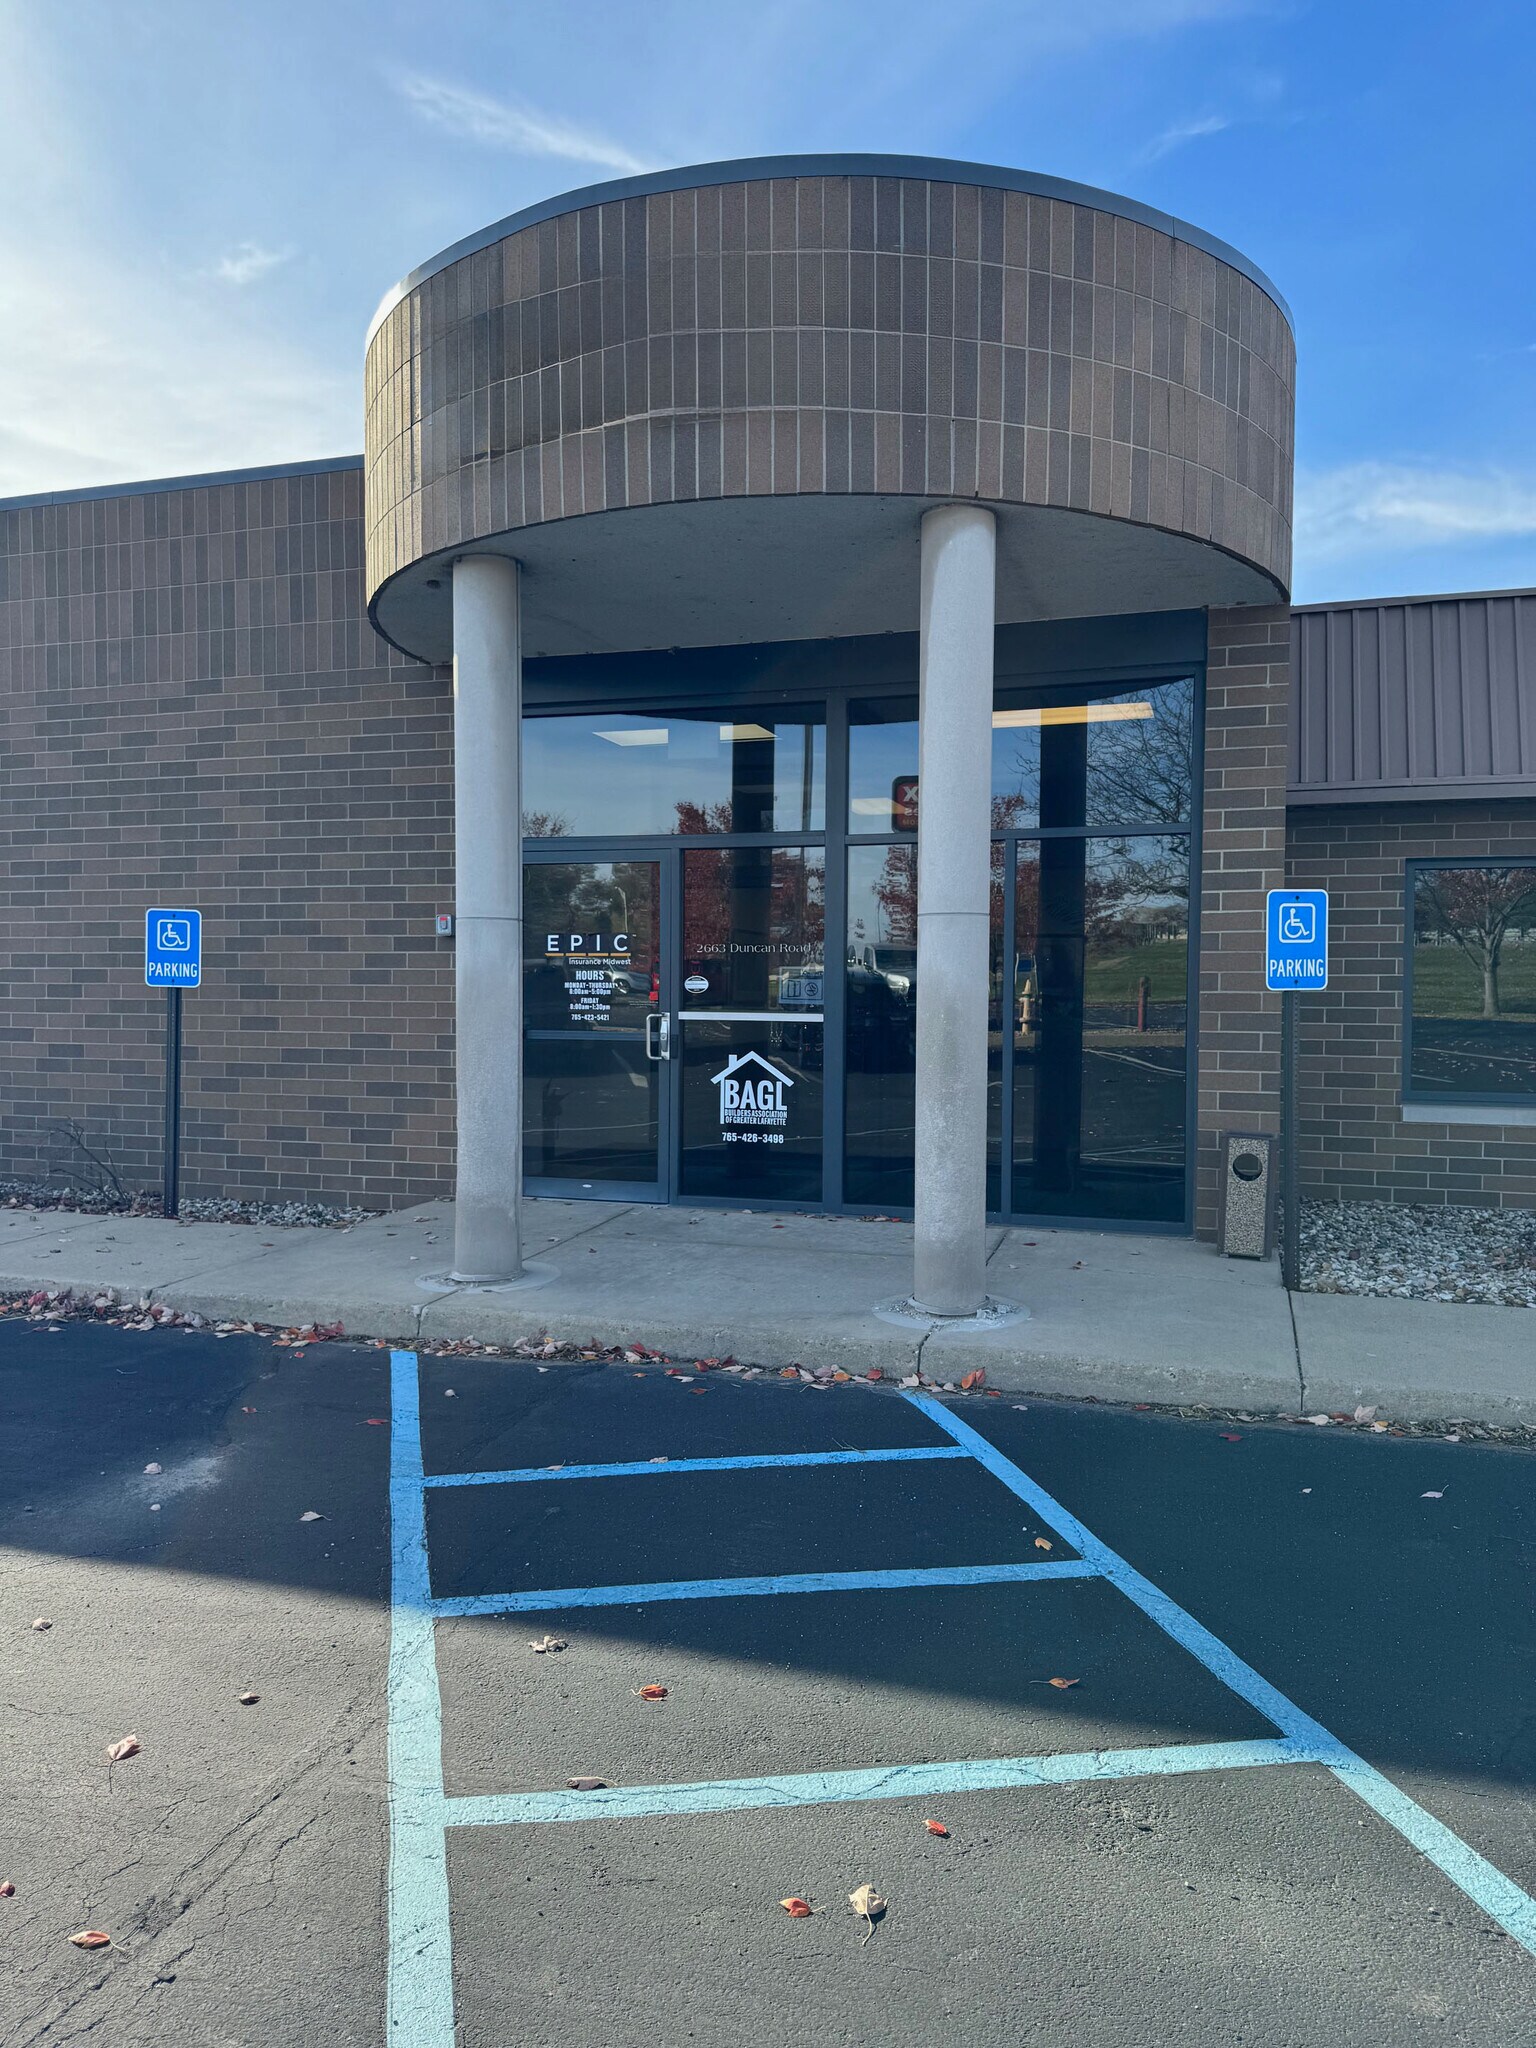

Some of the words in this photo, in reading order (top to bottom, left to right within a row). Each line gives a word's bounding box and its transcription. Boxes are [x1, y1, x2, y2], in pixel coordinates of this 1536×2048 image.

[547, 934, 628, 951] EPIC
[697, 943, 726, 953] 2663
[730, 943, 776, 953] Duncan
[780, 943, 811, 953] Road
[148, 962, 198, 977] PARKING
[1270, 959, 1324, 977] PARKING
[575, 970, 604, 980] HOURS
[724, 1080, 788, 1110] BAGL
[724, 1109, 751, 1117] BUILDERS
[751, 1110, 788, 1118] ASSOCIATION
[733, 1116, 757, 1124] GREATER
[757, 1118, 786, 1126] LAFAYETTE
[722, 1132, 784, 1144] 765-426-3498
